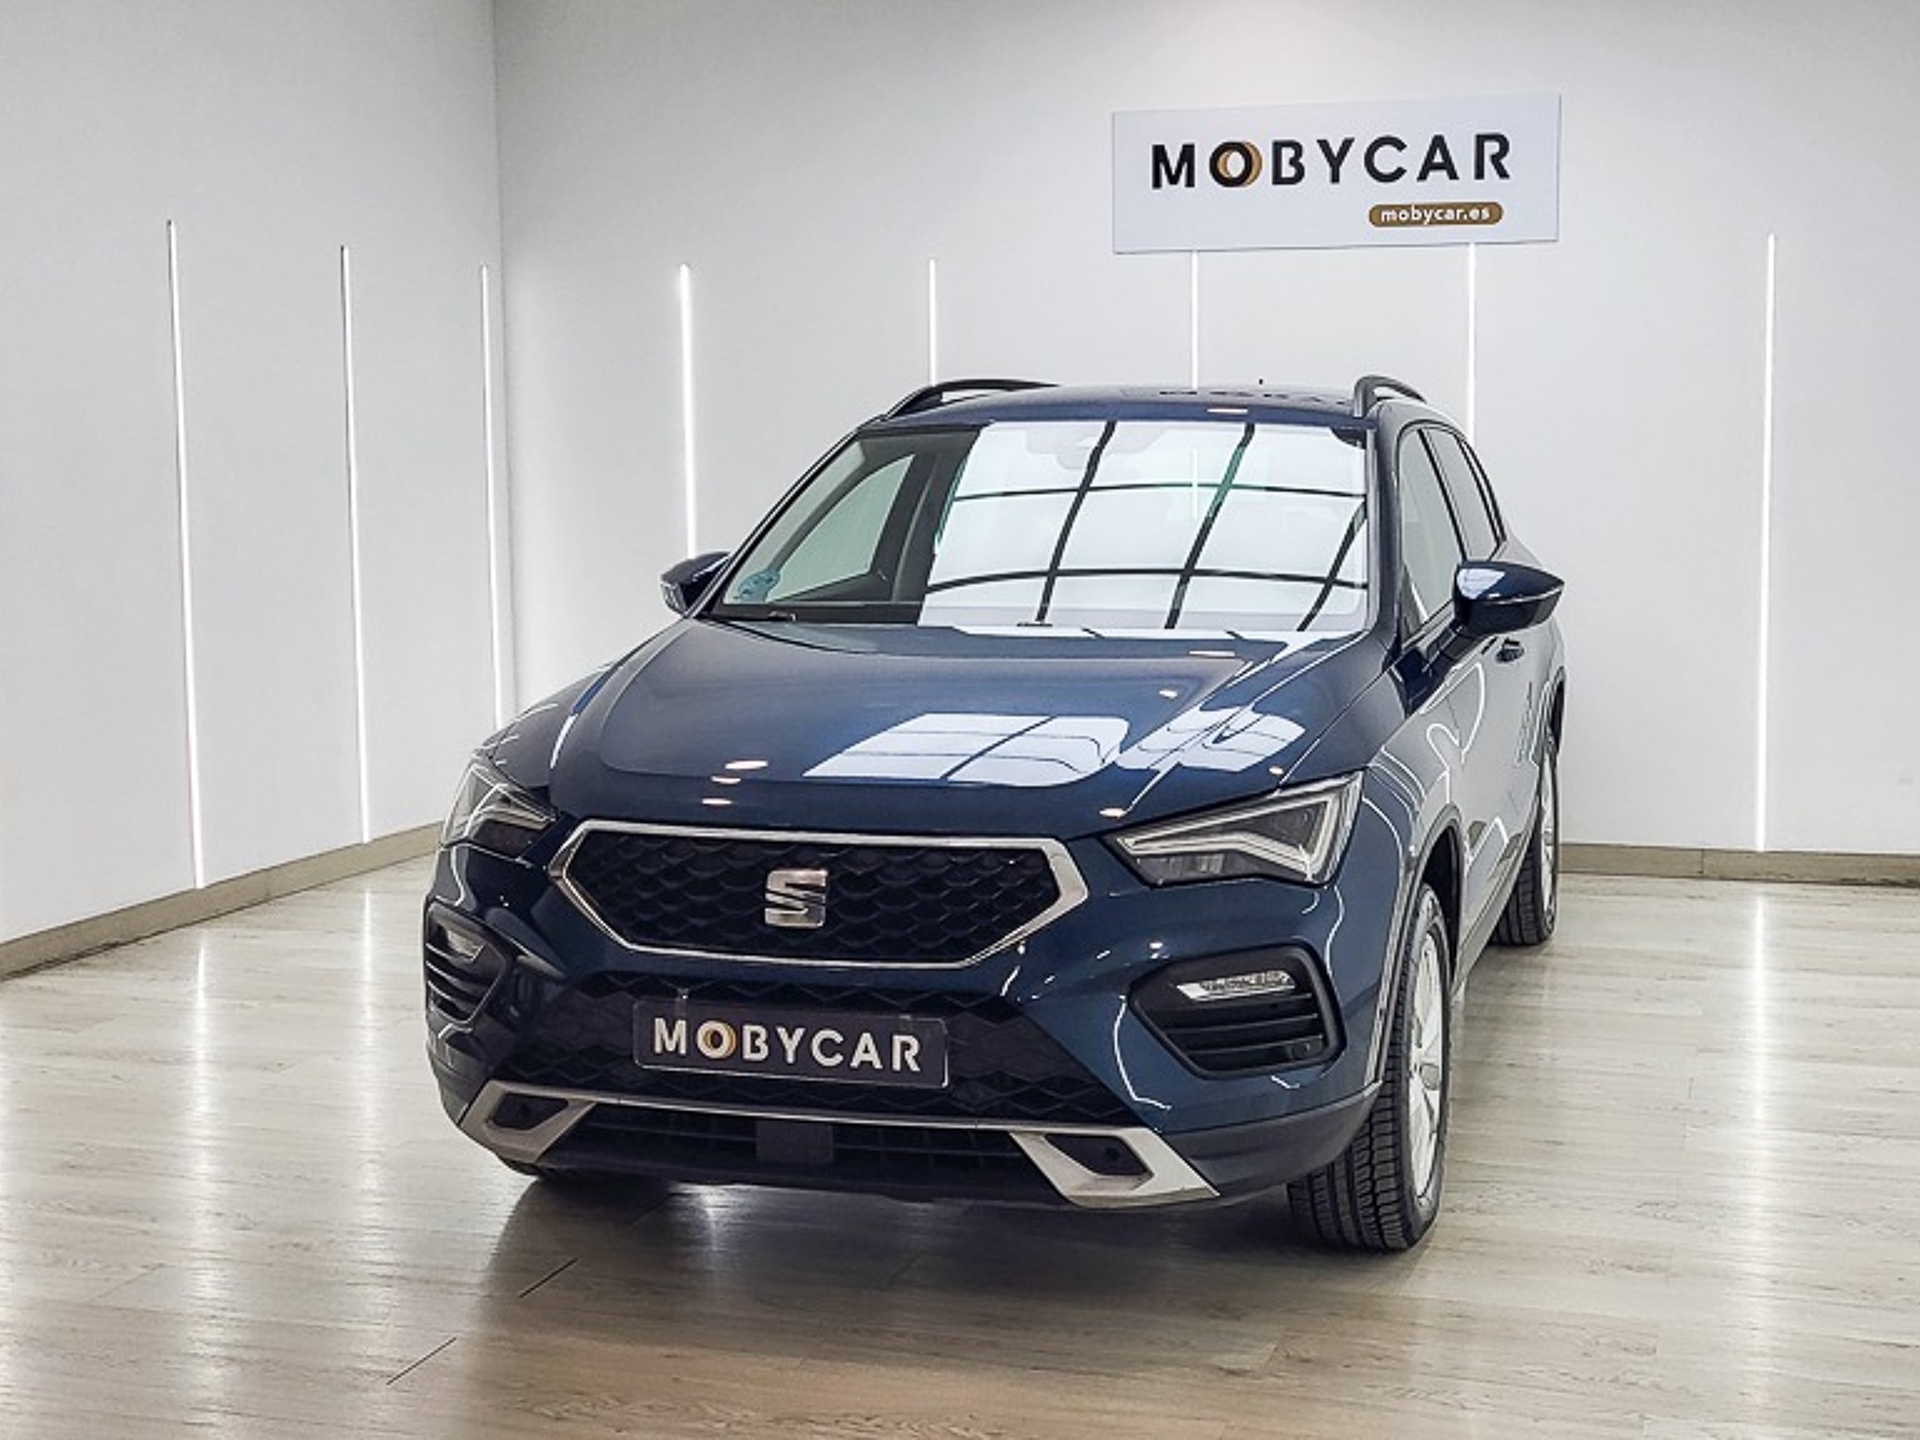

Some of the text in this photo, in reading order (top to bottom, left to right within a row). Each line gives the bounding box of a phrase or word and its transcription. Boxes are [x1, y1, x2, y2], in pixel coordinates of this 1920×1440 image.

[1151, 133, 1511, 189] MOBYCAR
[1380, 205, 1491, 225] mobycar.es
[653, 1017, 921, 1072] MOBYCAR
